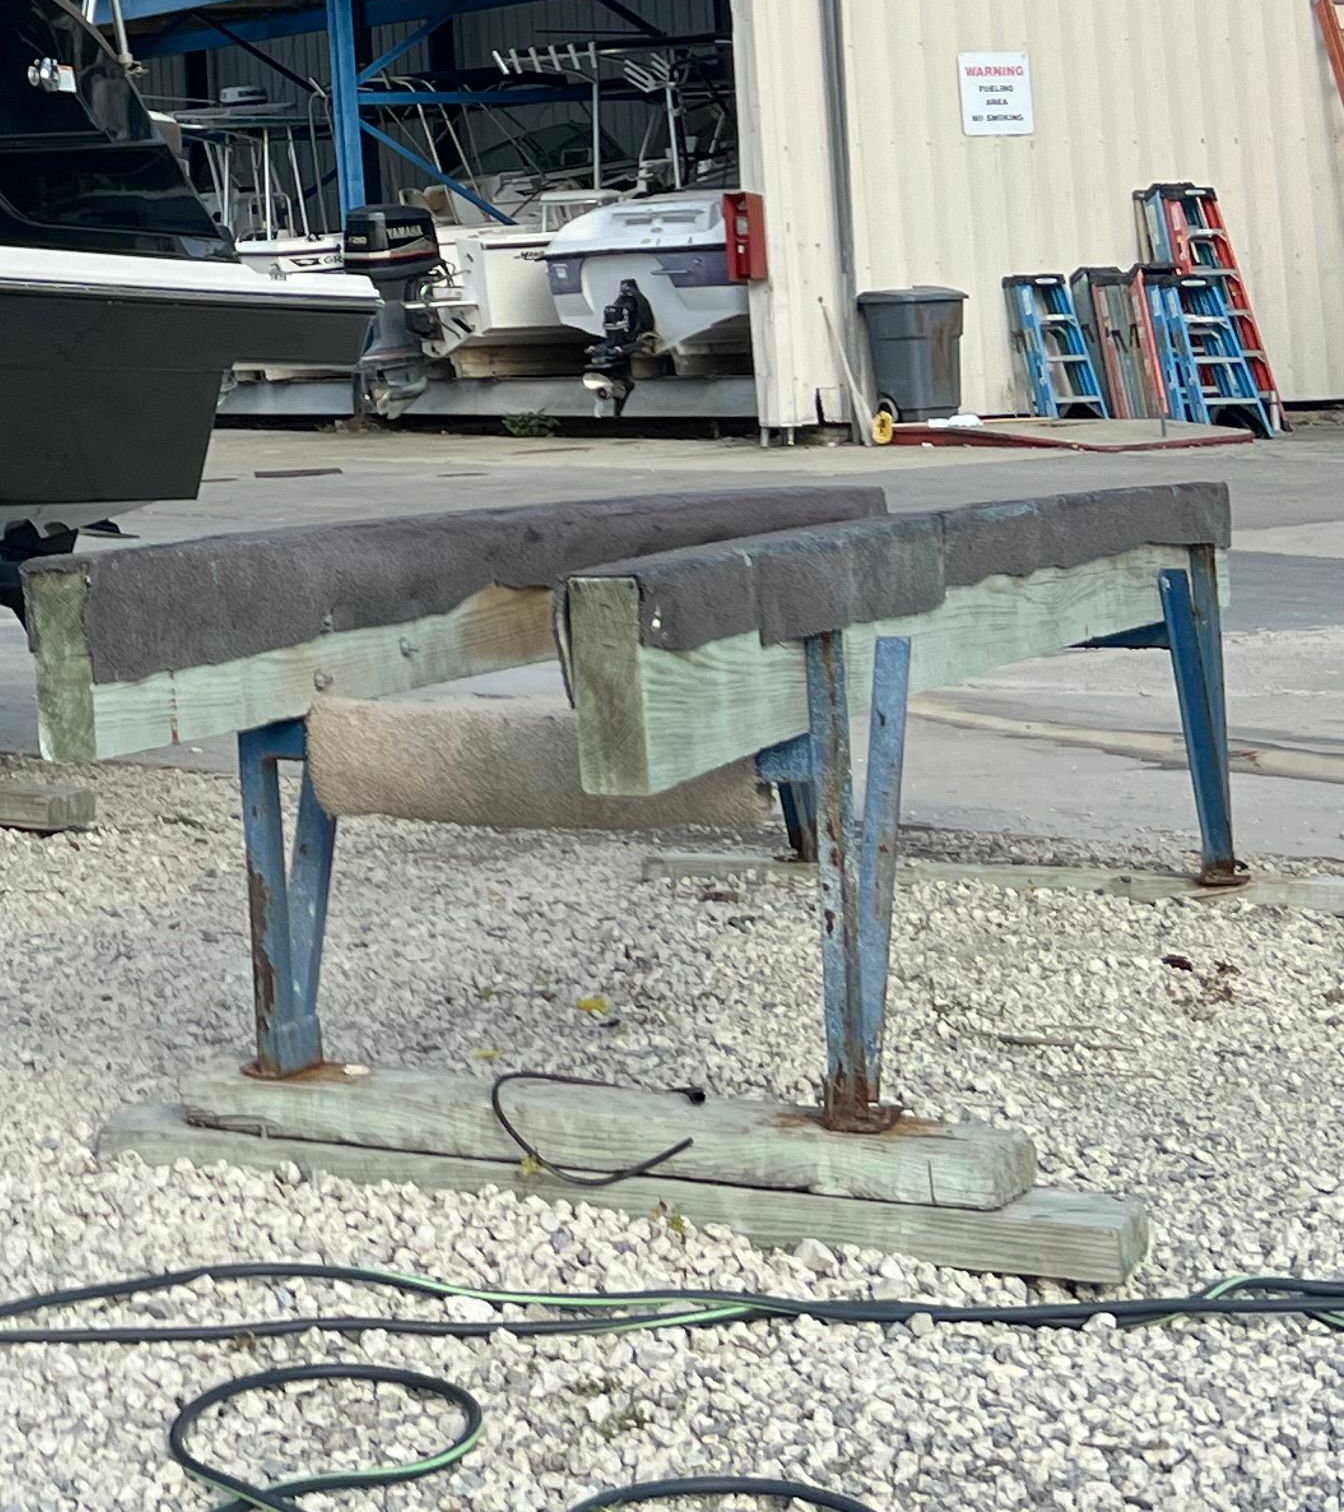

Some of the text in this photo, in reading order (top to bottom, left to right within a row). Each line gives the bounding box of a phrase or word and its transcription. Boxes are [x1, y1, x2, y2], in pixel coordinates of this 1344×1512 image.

[965, 66, 1024, 76] WARNING
[986, 114, 1024, 122] SMOKING
[387, 224, 424, 240] YAMAHA
